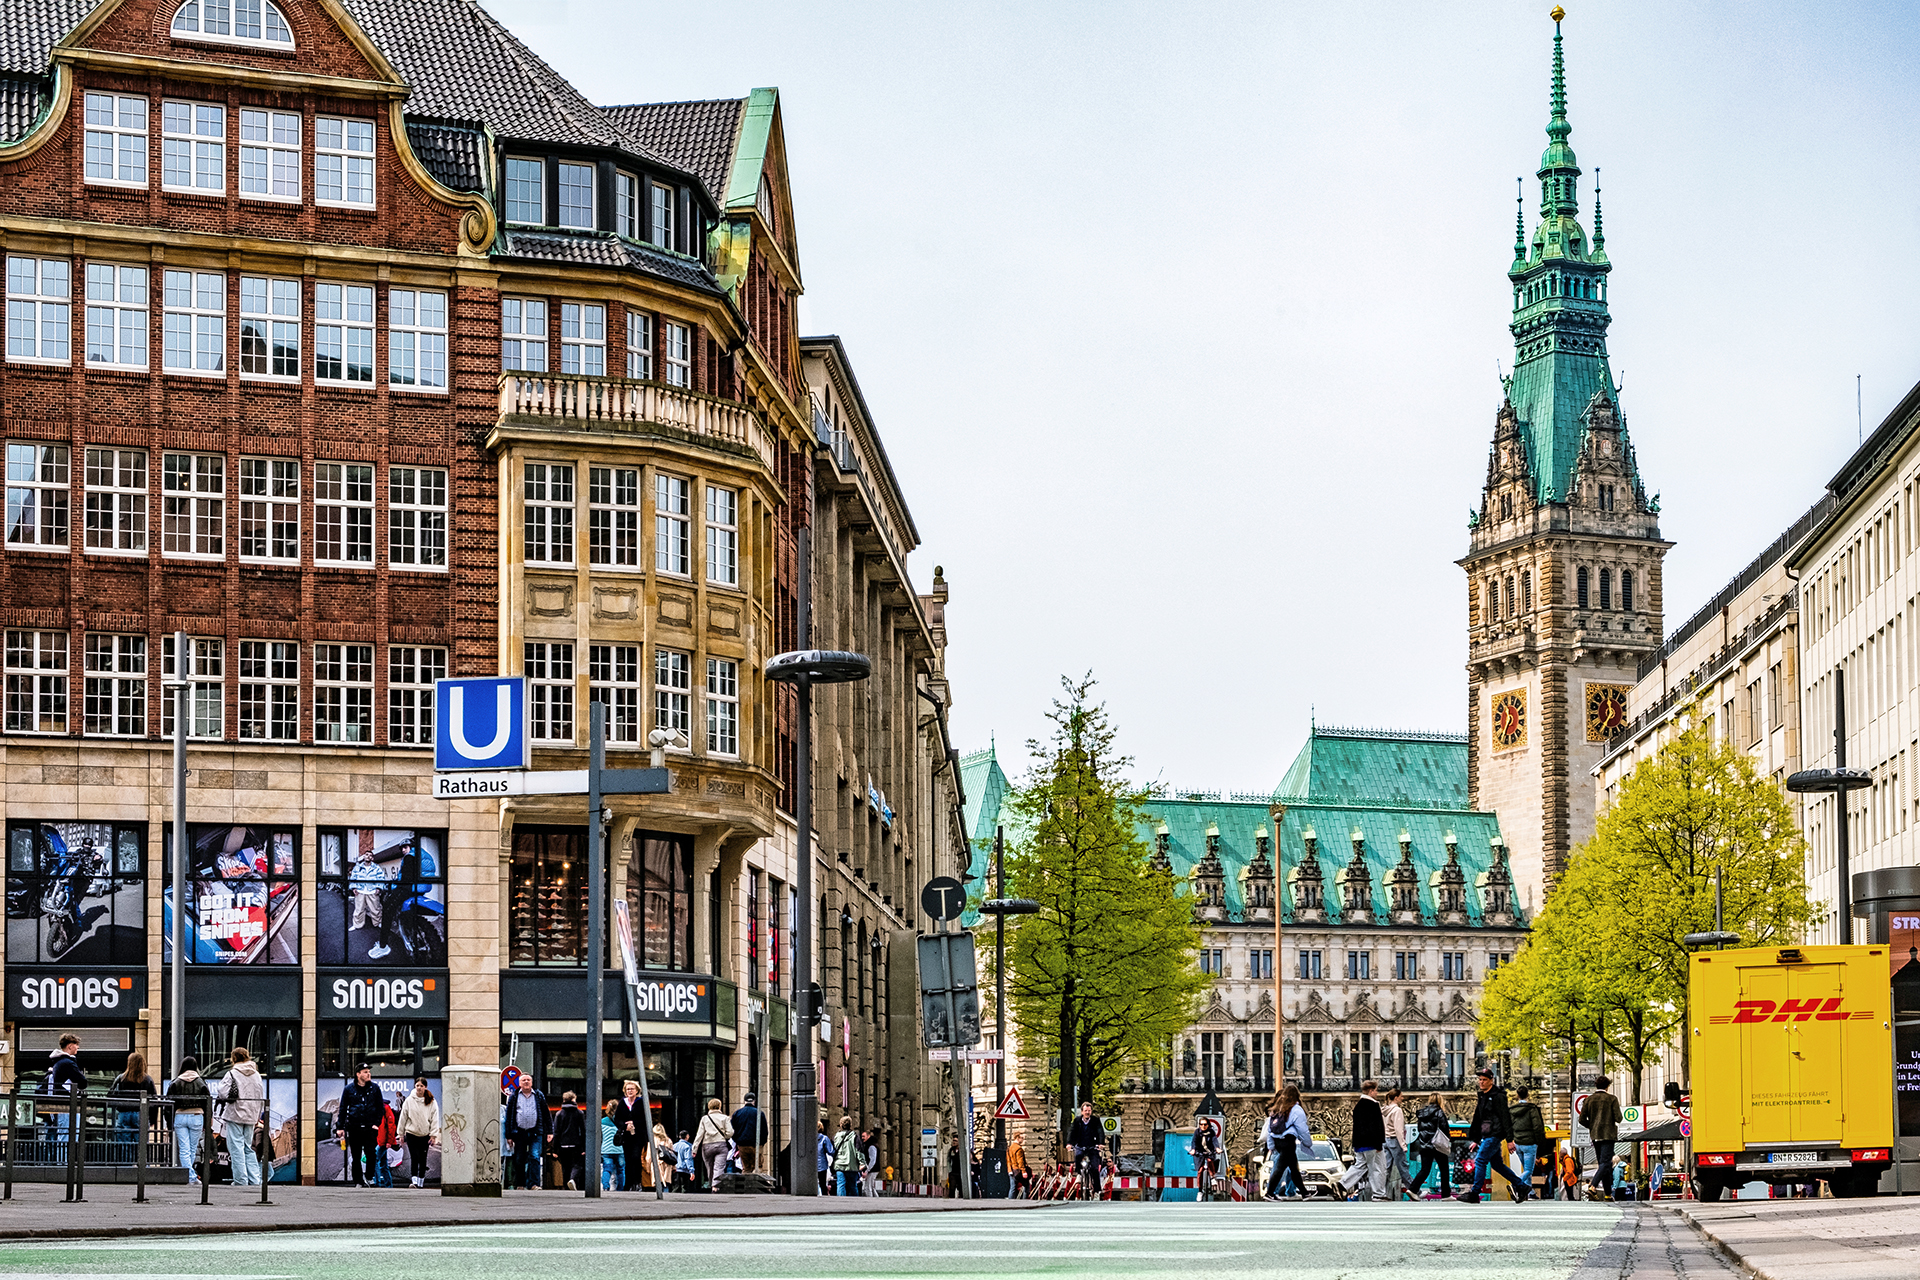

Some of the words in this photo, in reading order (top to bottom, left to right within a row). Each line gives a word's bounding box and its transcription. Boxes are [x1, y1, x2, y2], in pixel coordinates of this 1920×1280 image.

[449, 684, 511, 760] U
[439, 777, 509, 794] Rathaus
[200, 893, 235, 910] GOT
[236, 892, 254, 908] IT
[200, 907, 249, 925] FROM
[200, 921, 264, 940] SNIPES
[21, 977, 119, 1015] snipes
[332, 978, 424, 1015] snipes
[636, 981, 698, 1018] snipes
[1731, 997, 1852, 1024] DHL
[1896, 1072, 1906, 1081] in
